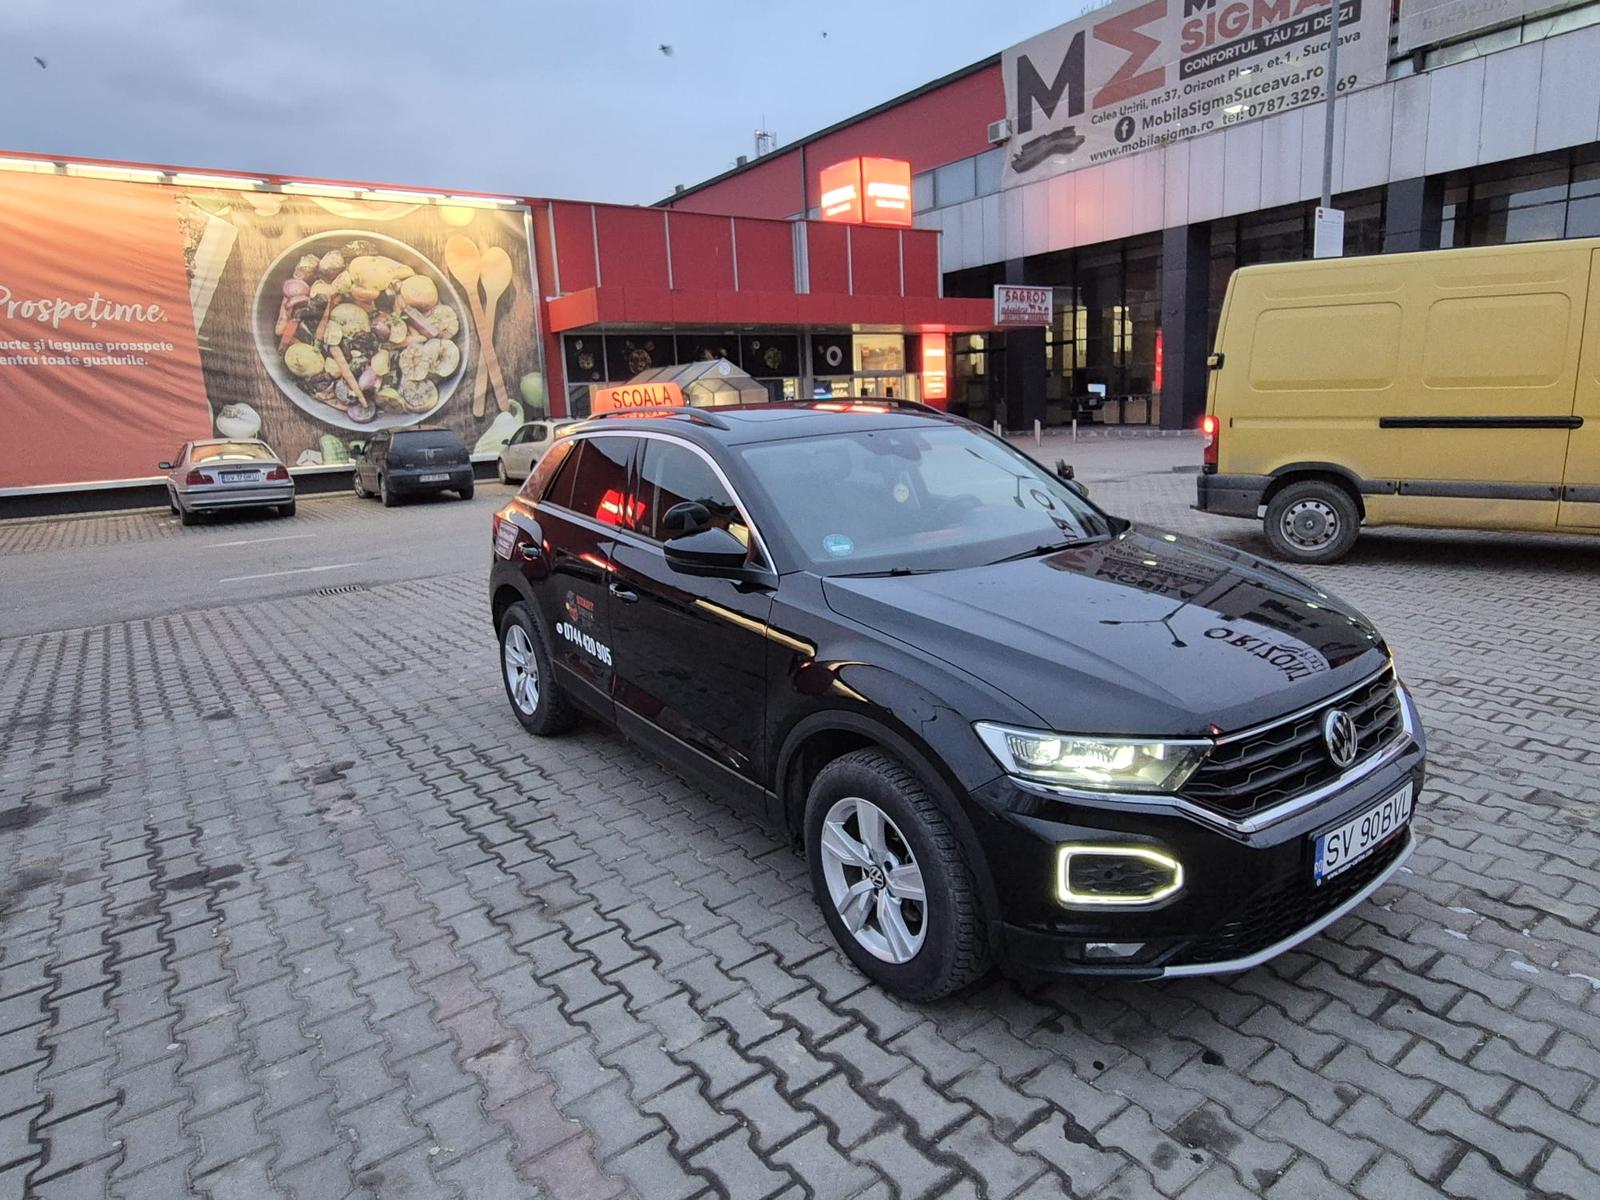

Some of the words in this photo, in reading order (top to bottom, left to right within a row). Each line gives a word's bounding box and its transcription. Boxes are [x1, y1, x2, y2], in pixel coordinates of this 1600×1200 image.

[1184, 42, 1259, 73] CONFORTUL
[1263, 28, 1291, 47] TĂU
[1294, 22, 1309, 37] ZI
[1314, 16, 1332, 30] DE
[1339, 6, 1354, 22] ZI
[1091, 110, 1117, 125] Calea
[1151, 89, 1181, 107] nr.37,
[1184, 73, 1225, 95] Orizont
[1303, 31, 1361, 57] Sucava
[1142, 66, 1324, 130] MobilaSigmaSuceava.ro
[1090, 120, 1214, 162] www.mobilasigma.ro
[1248, 75, 1357, 117] 0787.329.69
[42, 355, 81, 366] toate
[83, 355, 148, 367] gusturile.
[49, 339, 106, 352] legume
[106, 341, 174, 352] proaspete
[611, 386, 673, 409] SCOALA
[563, 622, 582, 647] 0744
[582, 633, 596, 656] 420
[1326, 825, 1355, 867] SV
